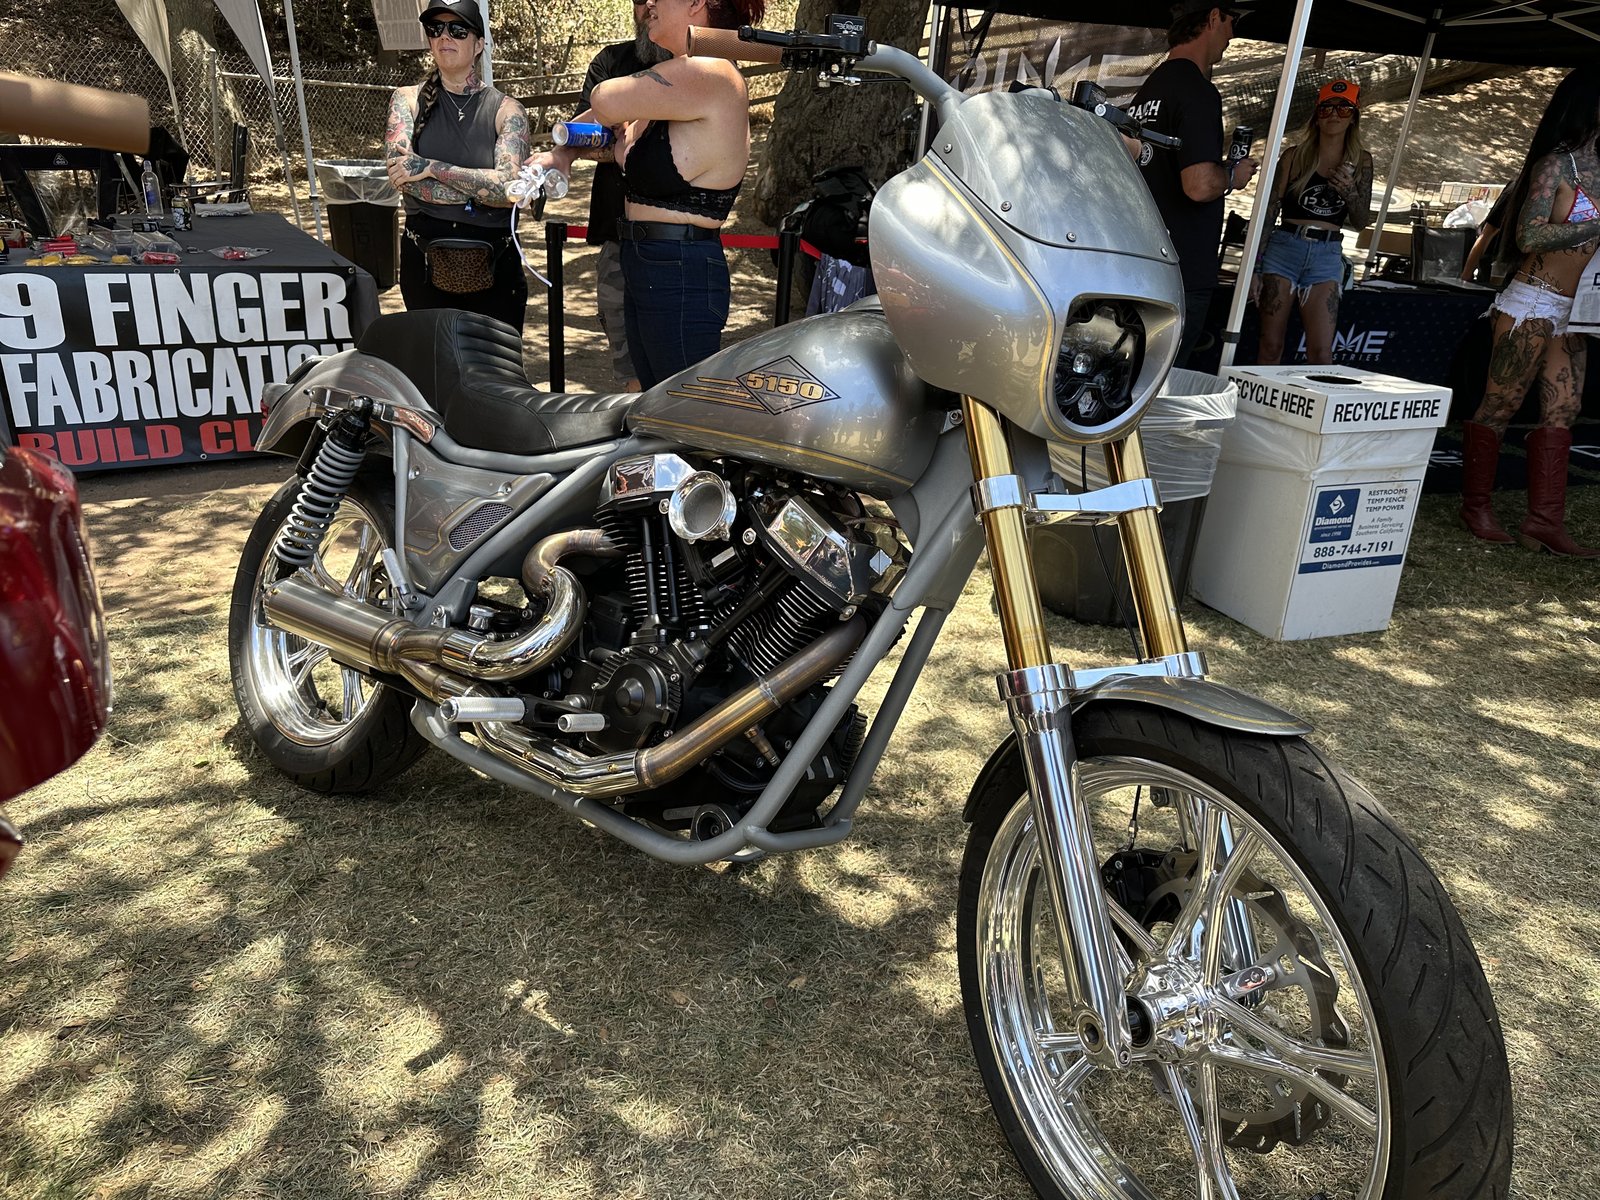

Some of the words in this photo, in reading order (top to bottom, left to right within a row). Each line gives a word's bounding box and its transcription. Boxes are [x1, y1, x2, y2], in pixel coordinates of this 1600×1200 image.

[0, 273, 66, 350] 9
[84, 272, 354, 347] FINGER
[1, 343, 355, 428] FABRICATI
[747, 373, 824, 400] 5150
[1280, 391, 1315, 419] HERE
[1333, 401, 1400, 423] RECYCLE
[1402, 399, 1441, 419] HERE
[18, 424, 184, 466] BUILD
[200, 419, 266, 455] CL
[1368, 488, 1408, 496] RESTROOMS
[1315, 514, 1353, 526] Diamond
[1313, 541, 1393, 558] 888-744-7191
